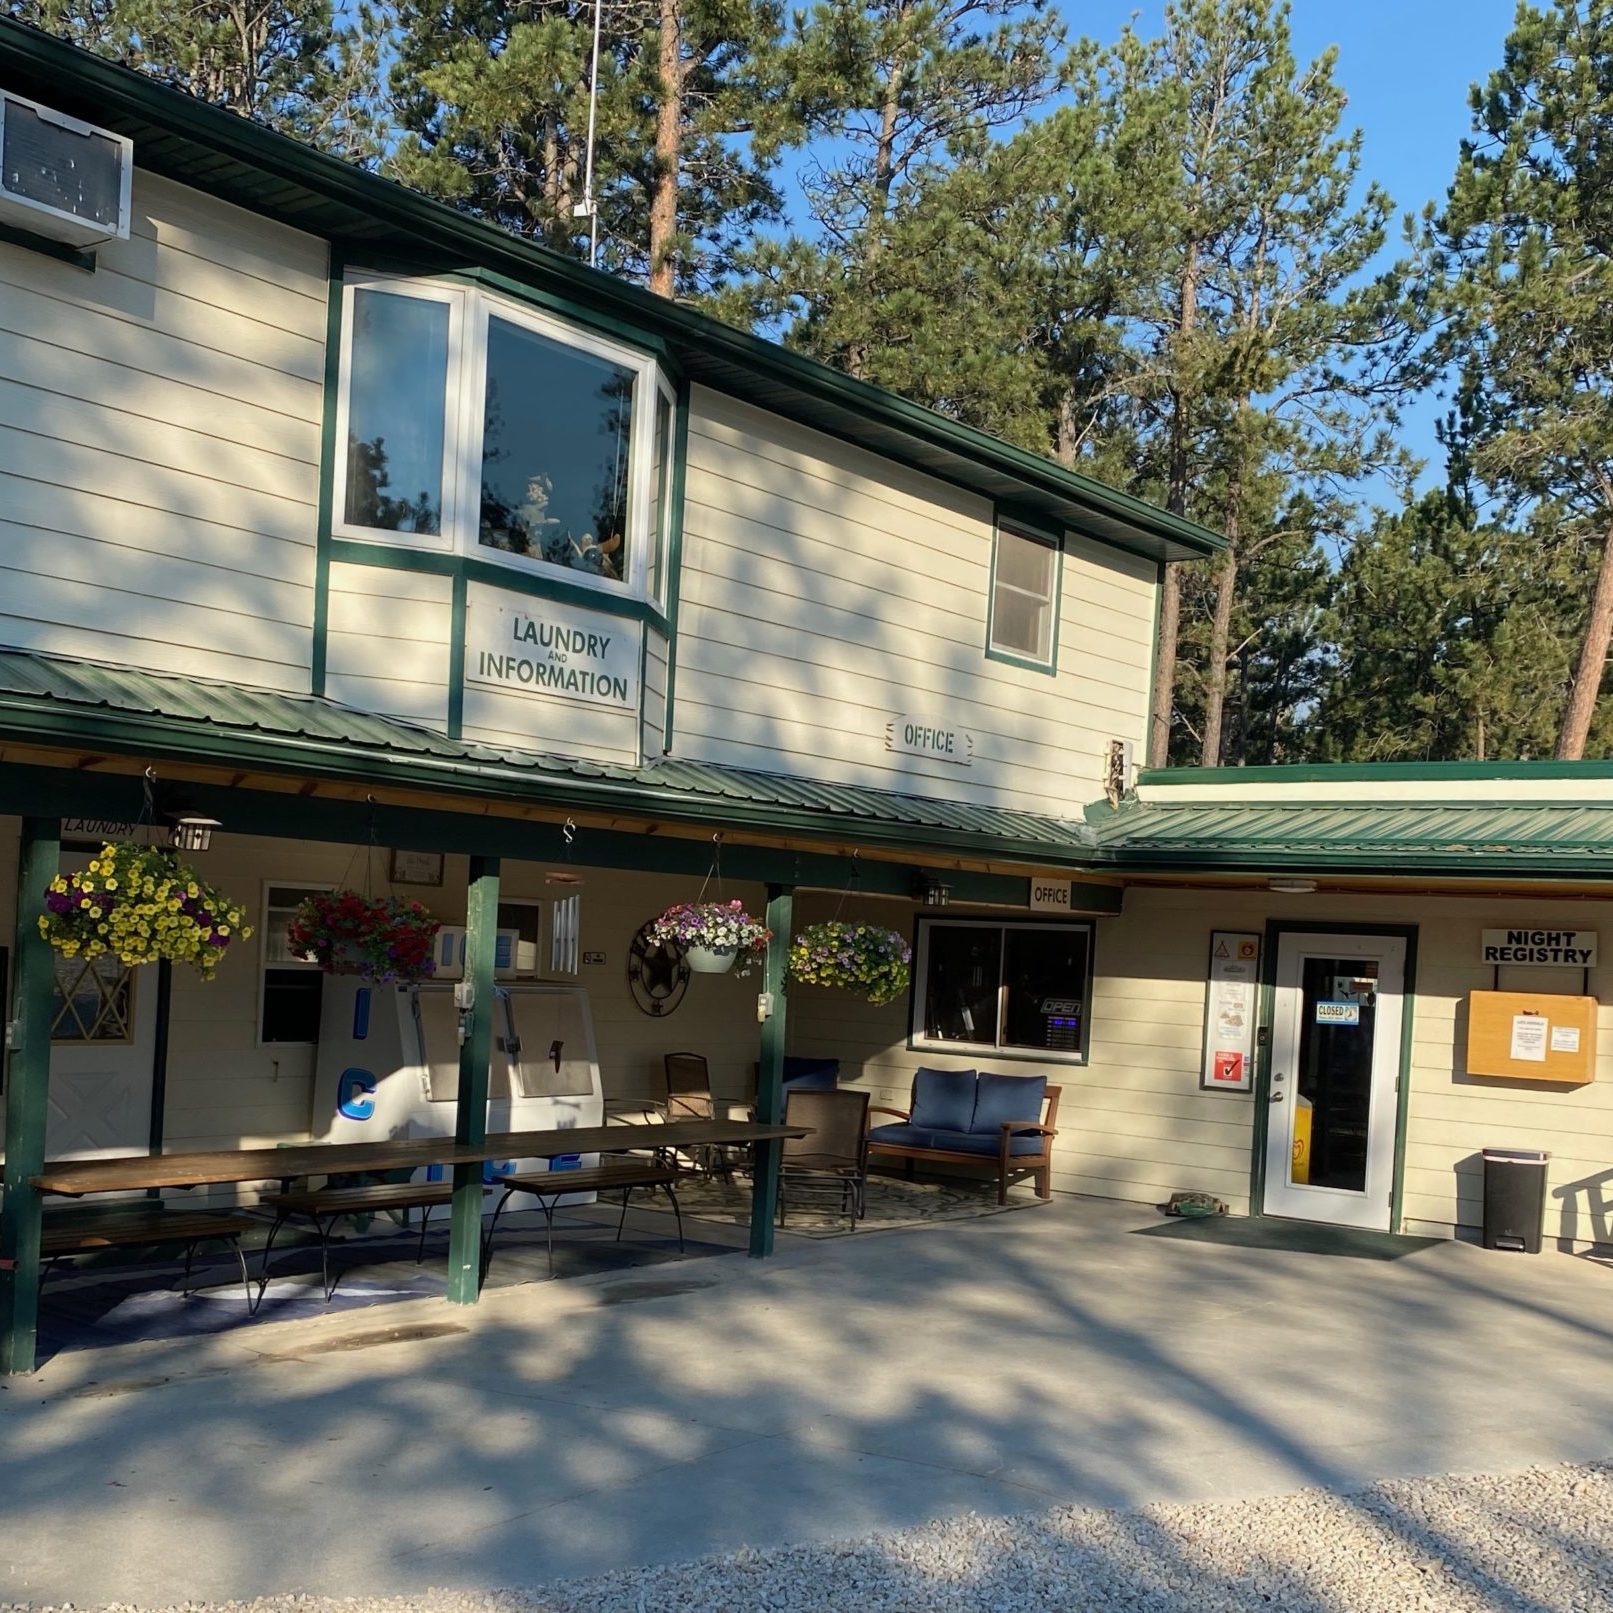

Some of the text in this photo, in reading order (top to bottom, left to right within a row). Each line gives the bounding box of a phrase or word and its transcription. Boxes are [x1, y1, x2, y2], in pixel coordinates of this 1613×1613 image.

[513, 617, 611, 659] LAUNDRY
[548, 650, 567, 663] AND
[480, 651, 627, 701] INFORMATION
[905, 724, 954, 753] OFFICE
[65, 818, 135, 836] LAUNDRY
[1035, 887, 1067, 904] OFFICE
[1507, 930, 1576, 947] NIGHT
[1485, 946, 1592, 963] REGISTRY
[1043, 1001, 1081, 1013] OPEN
[1318, 1005, 1344, 1016] CLOSED
